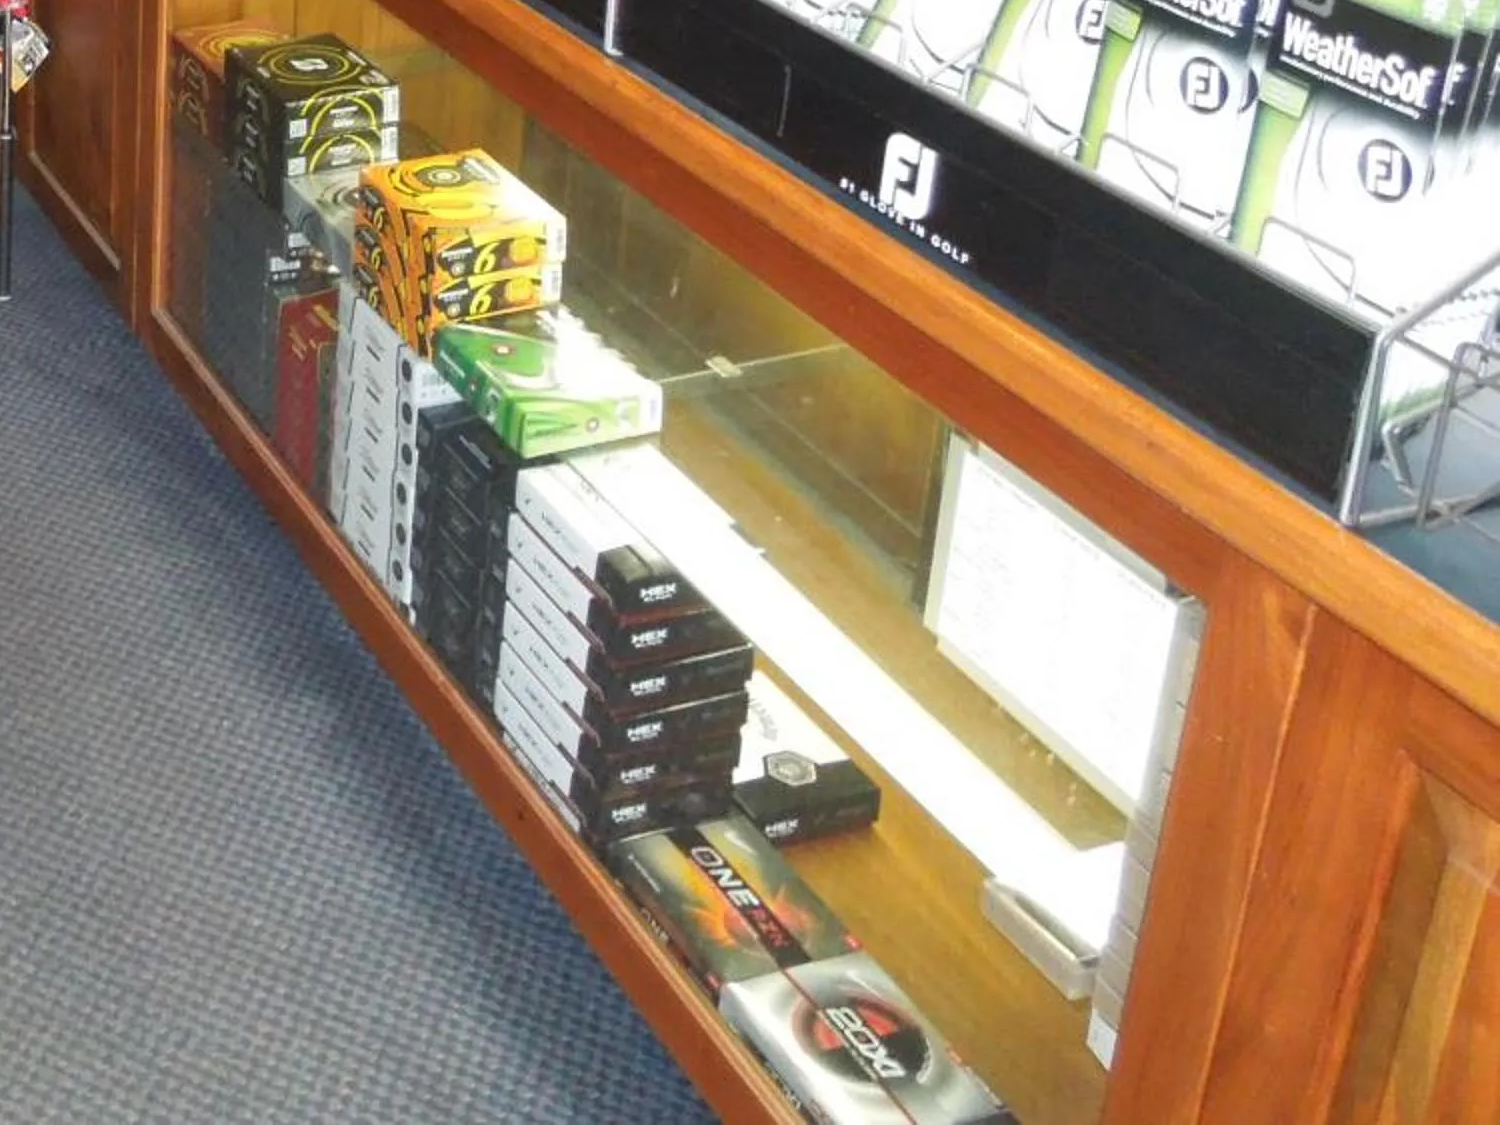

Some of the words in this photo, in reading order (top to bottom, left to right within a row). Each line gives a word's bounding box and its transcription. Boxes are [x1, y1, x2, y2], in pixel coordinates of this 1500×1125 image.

[1282, 10, 1437, 109] WeatherSof
[859, 189, 904, 225] GLOVE
[910, 222, 925, 238] IN
[931, 234, 970, 264] GOLF
[640, 583, 676, 597] HEX
[631, 628, 668, 643] HEX
[691, 846, 761, 908] ONE
